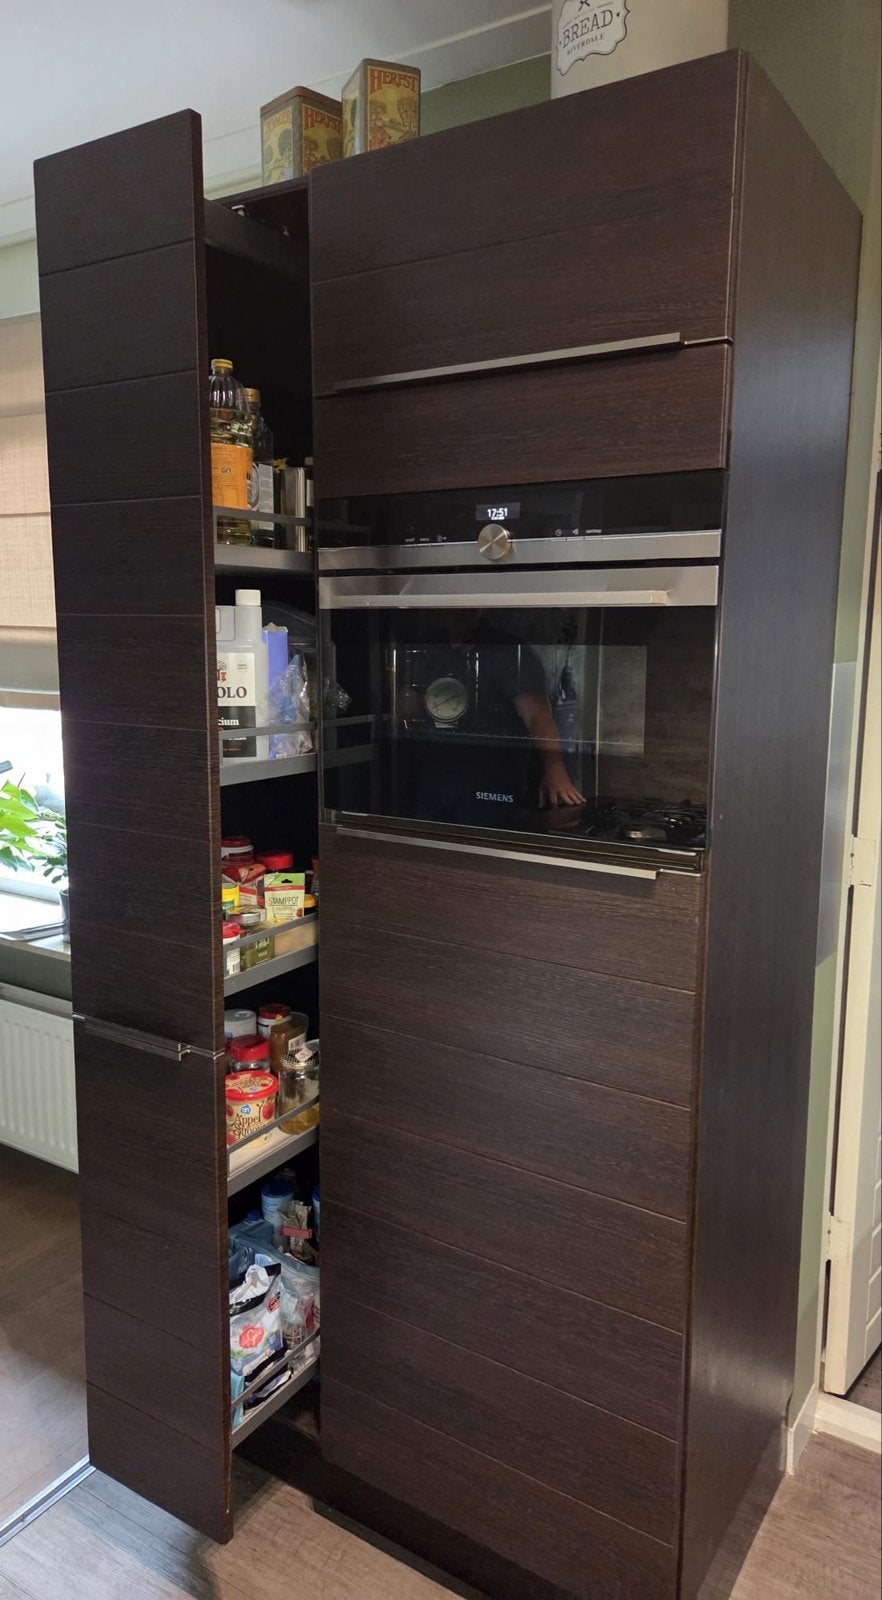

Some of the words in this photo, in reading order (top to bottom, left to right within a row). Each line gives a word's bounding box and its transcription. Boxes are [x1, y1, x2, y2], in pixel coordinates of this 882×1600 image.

[562, 9, 613, 48] BREAD
[370, 68, 417, 93] HERFST
[487, 507, 508, 518] 17:51
[476, 791, 514, 803] SIEMENS
[268, 896, 299, 905] STAMPPOT
[231, 1104, 262, 1127] Appel
